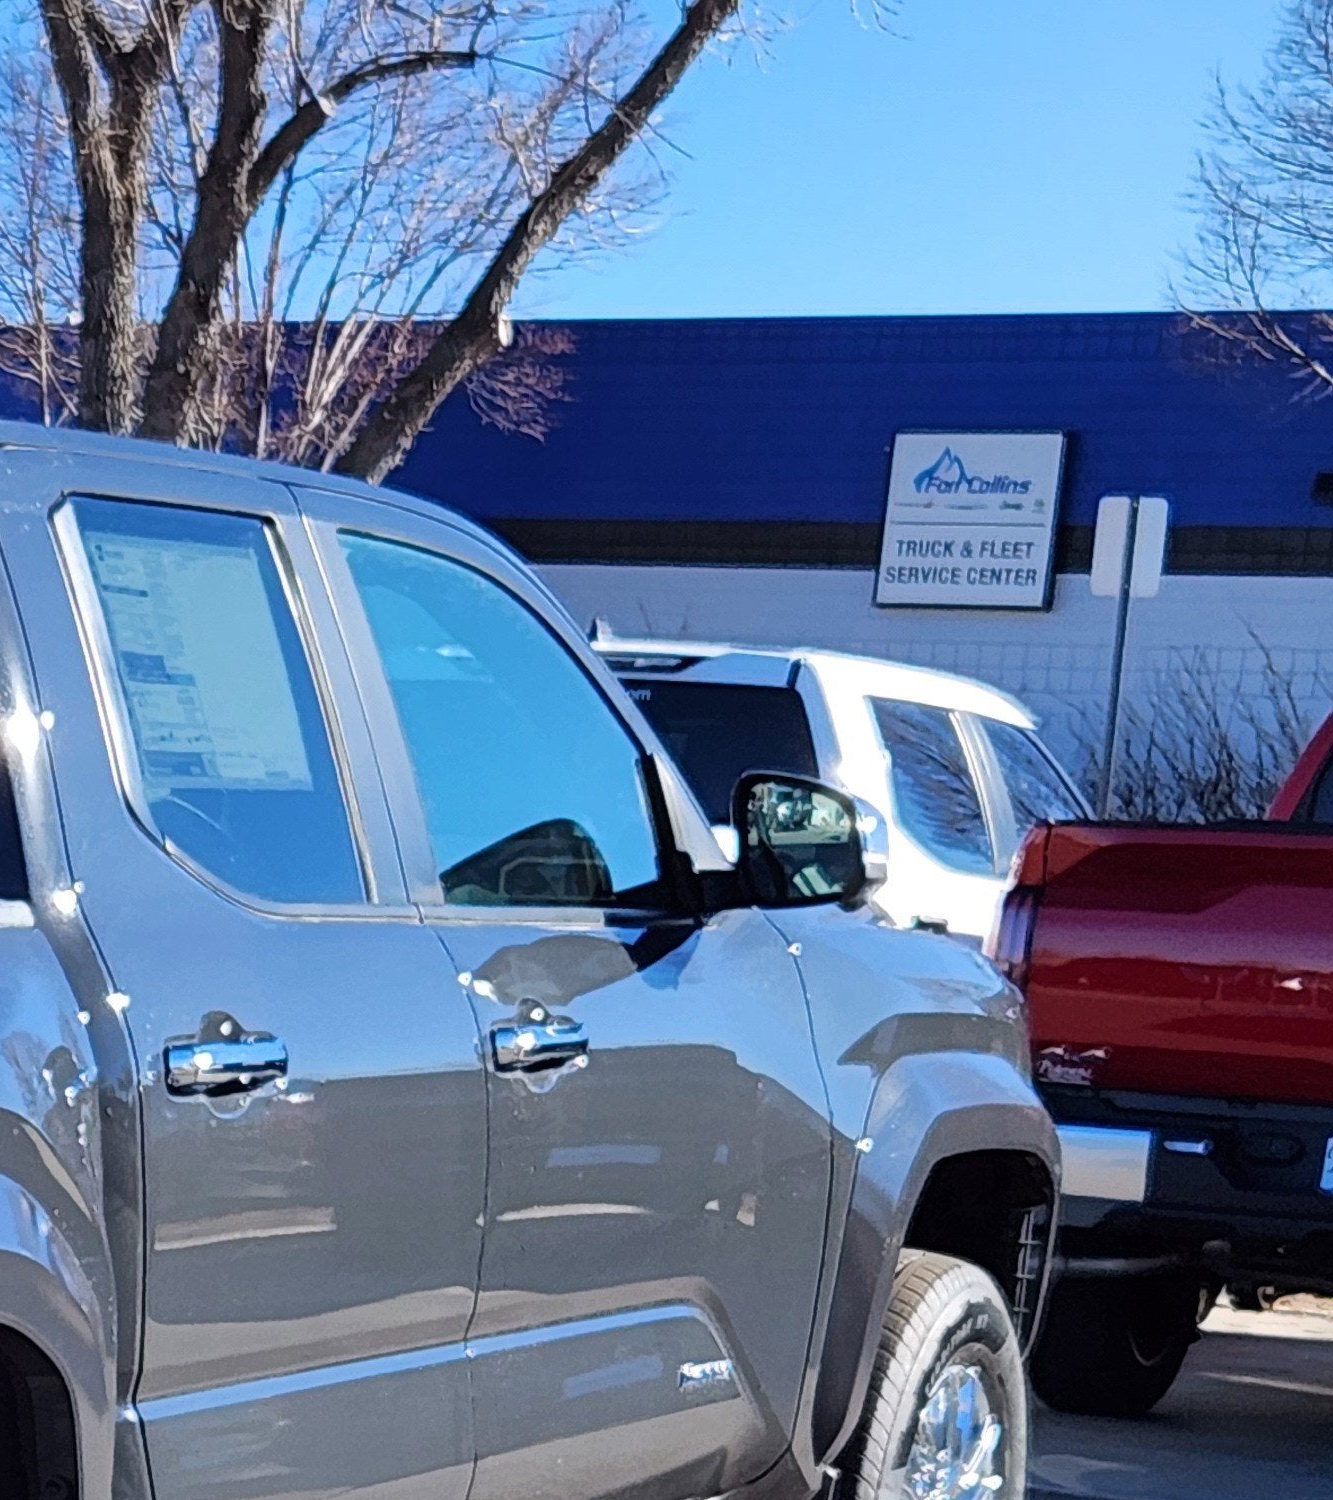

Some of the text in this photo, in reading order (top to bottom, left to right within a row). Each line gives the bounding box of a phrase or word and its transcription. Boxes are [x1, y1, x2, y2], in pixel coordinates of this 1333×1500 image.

[965, 474, 1033, 495] Collins
[896, 539, 1035, 560] TRUCK & FLEET
[884, 566, 1038, 586] SERVICE CENTER
